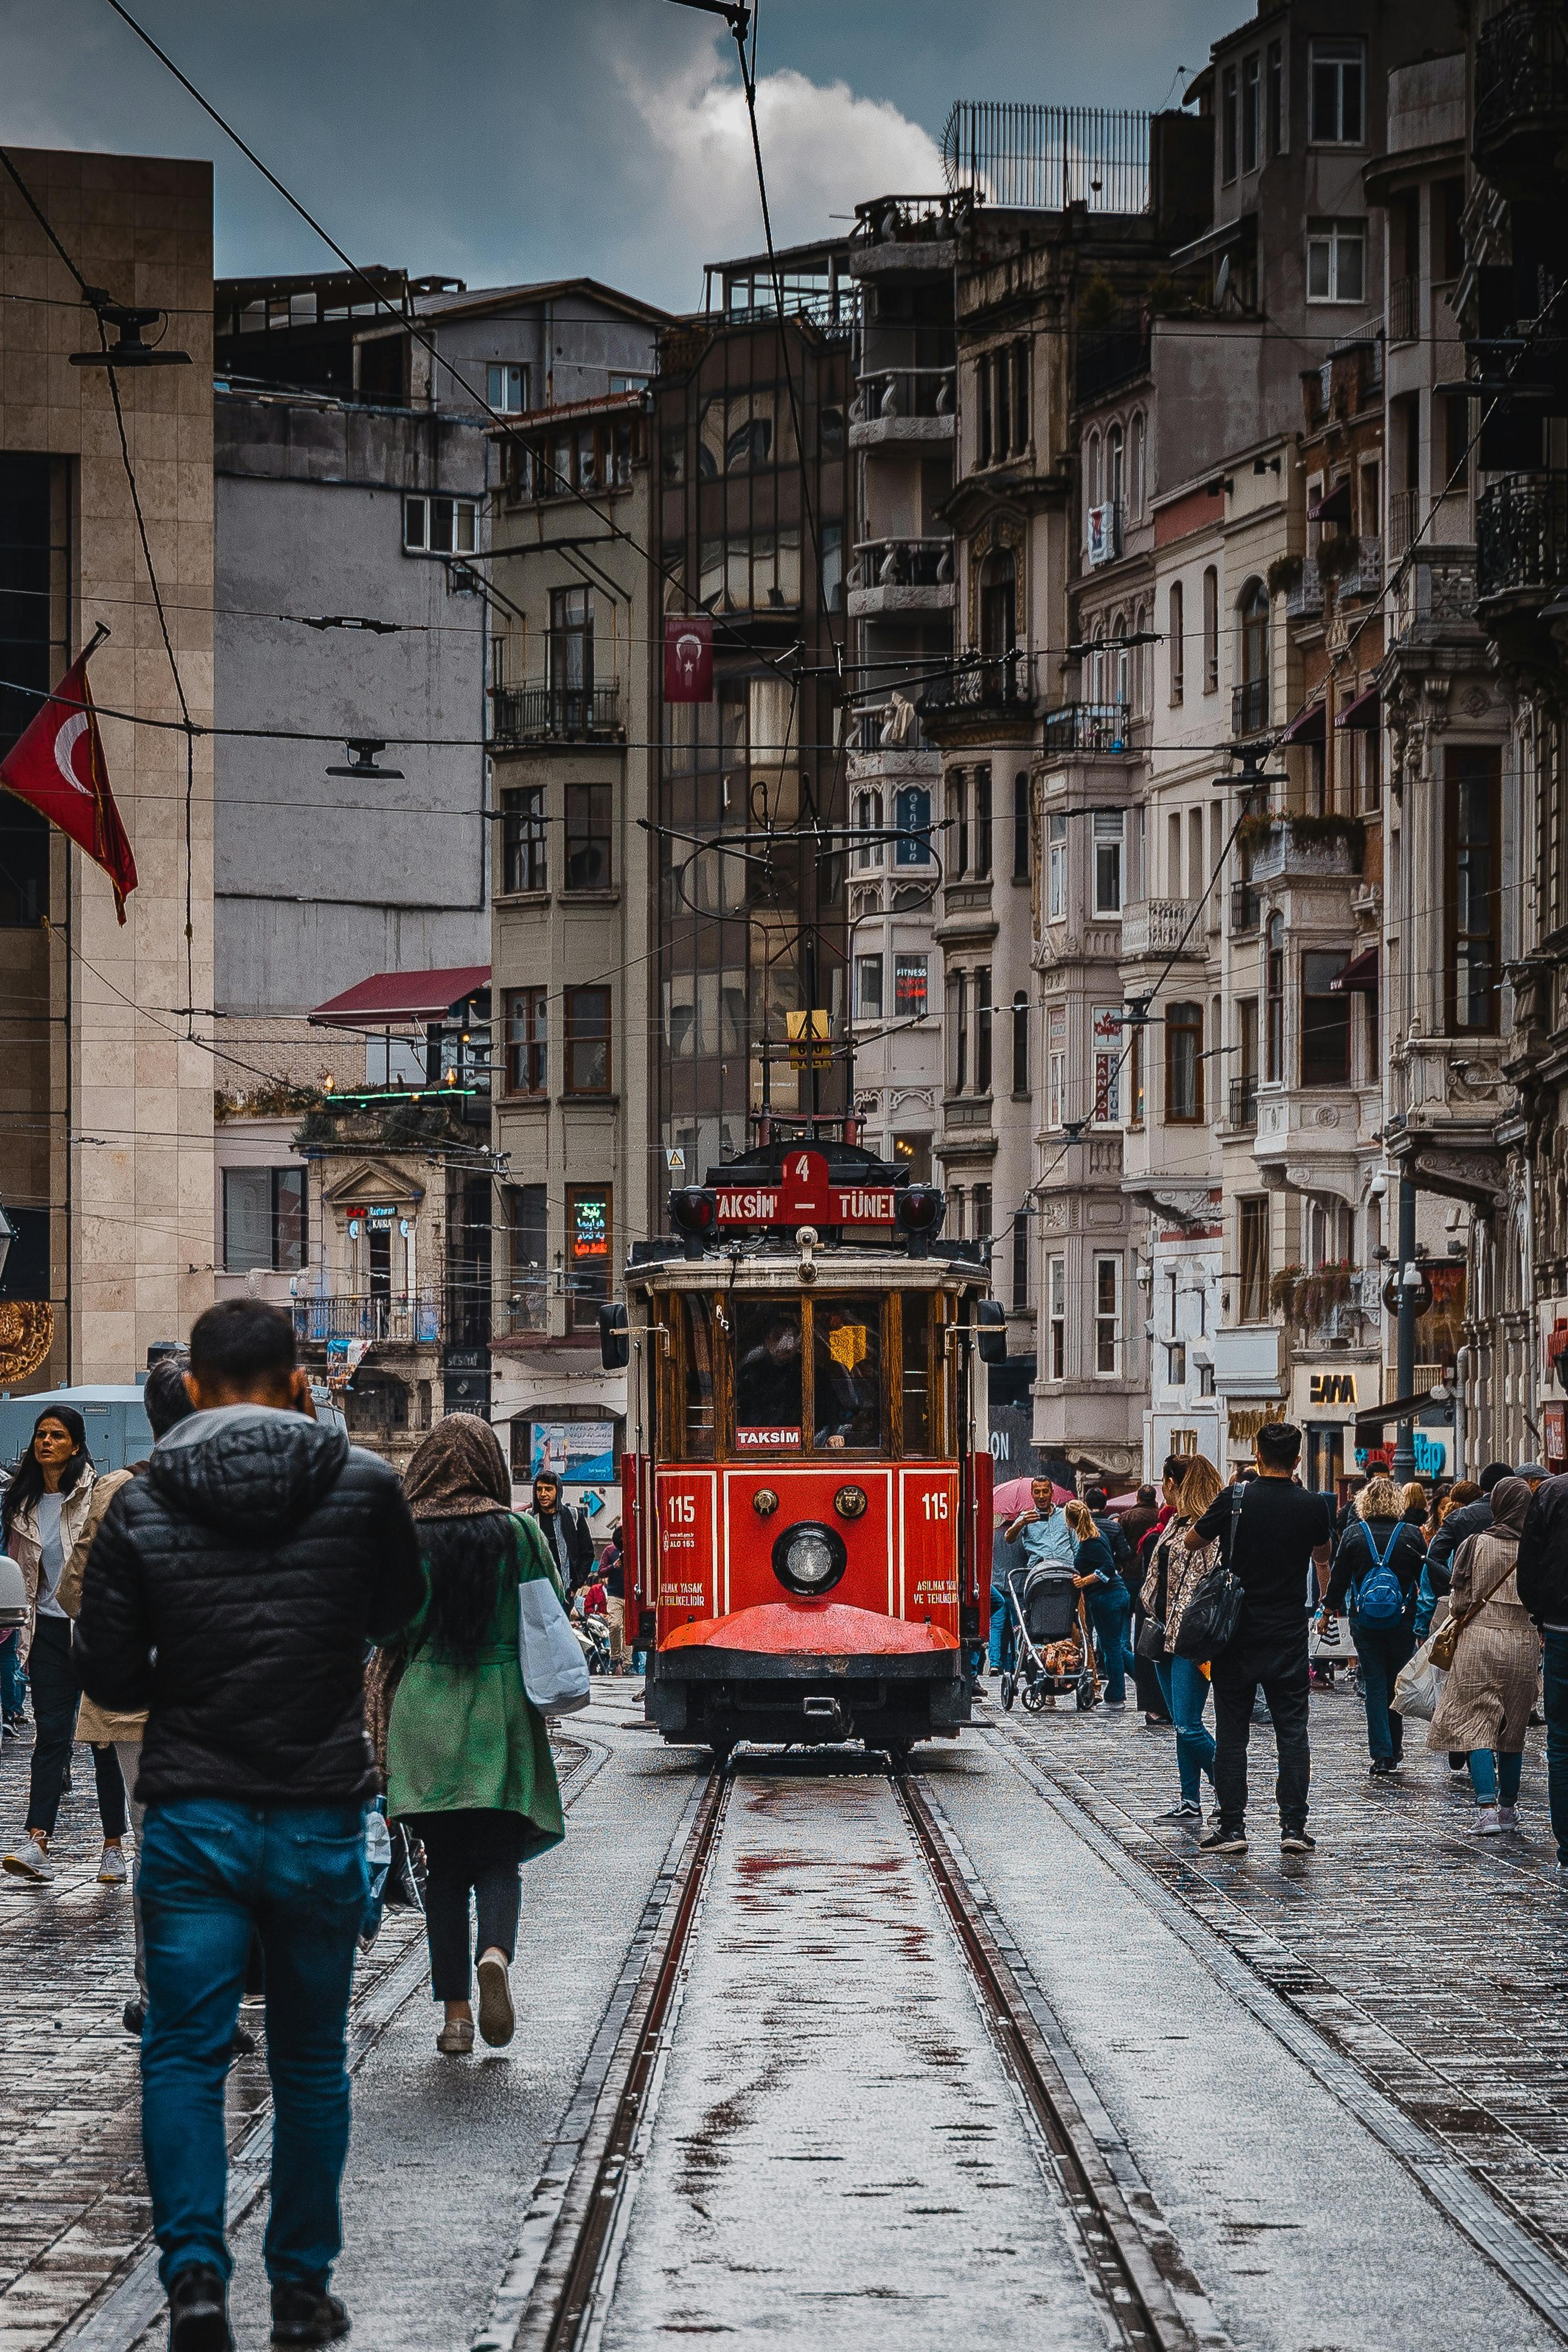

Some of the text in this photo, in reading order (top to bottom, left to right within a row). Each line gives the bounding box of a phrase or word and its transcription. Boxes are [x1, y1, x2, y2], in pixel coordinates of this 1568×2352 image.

[897, 968, 927, 976] FITNESS
[795, 1155, 809, 1182] 4
[737, 1430, 799, 1444] TAKSİM
[668, 1495, 695, 1523] 115
[922, 1493, 948, 1520] 115
[680, 1582, 703, 1594] YASAK
[913, 1593, 924, 1605] VE
